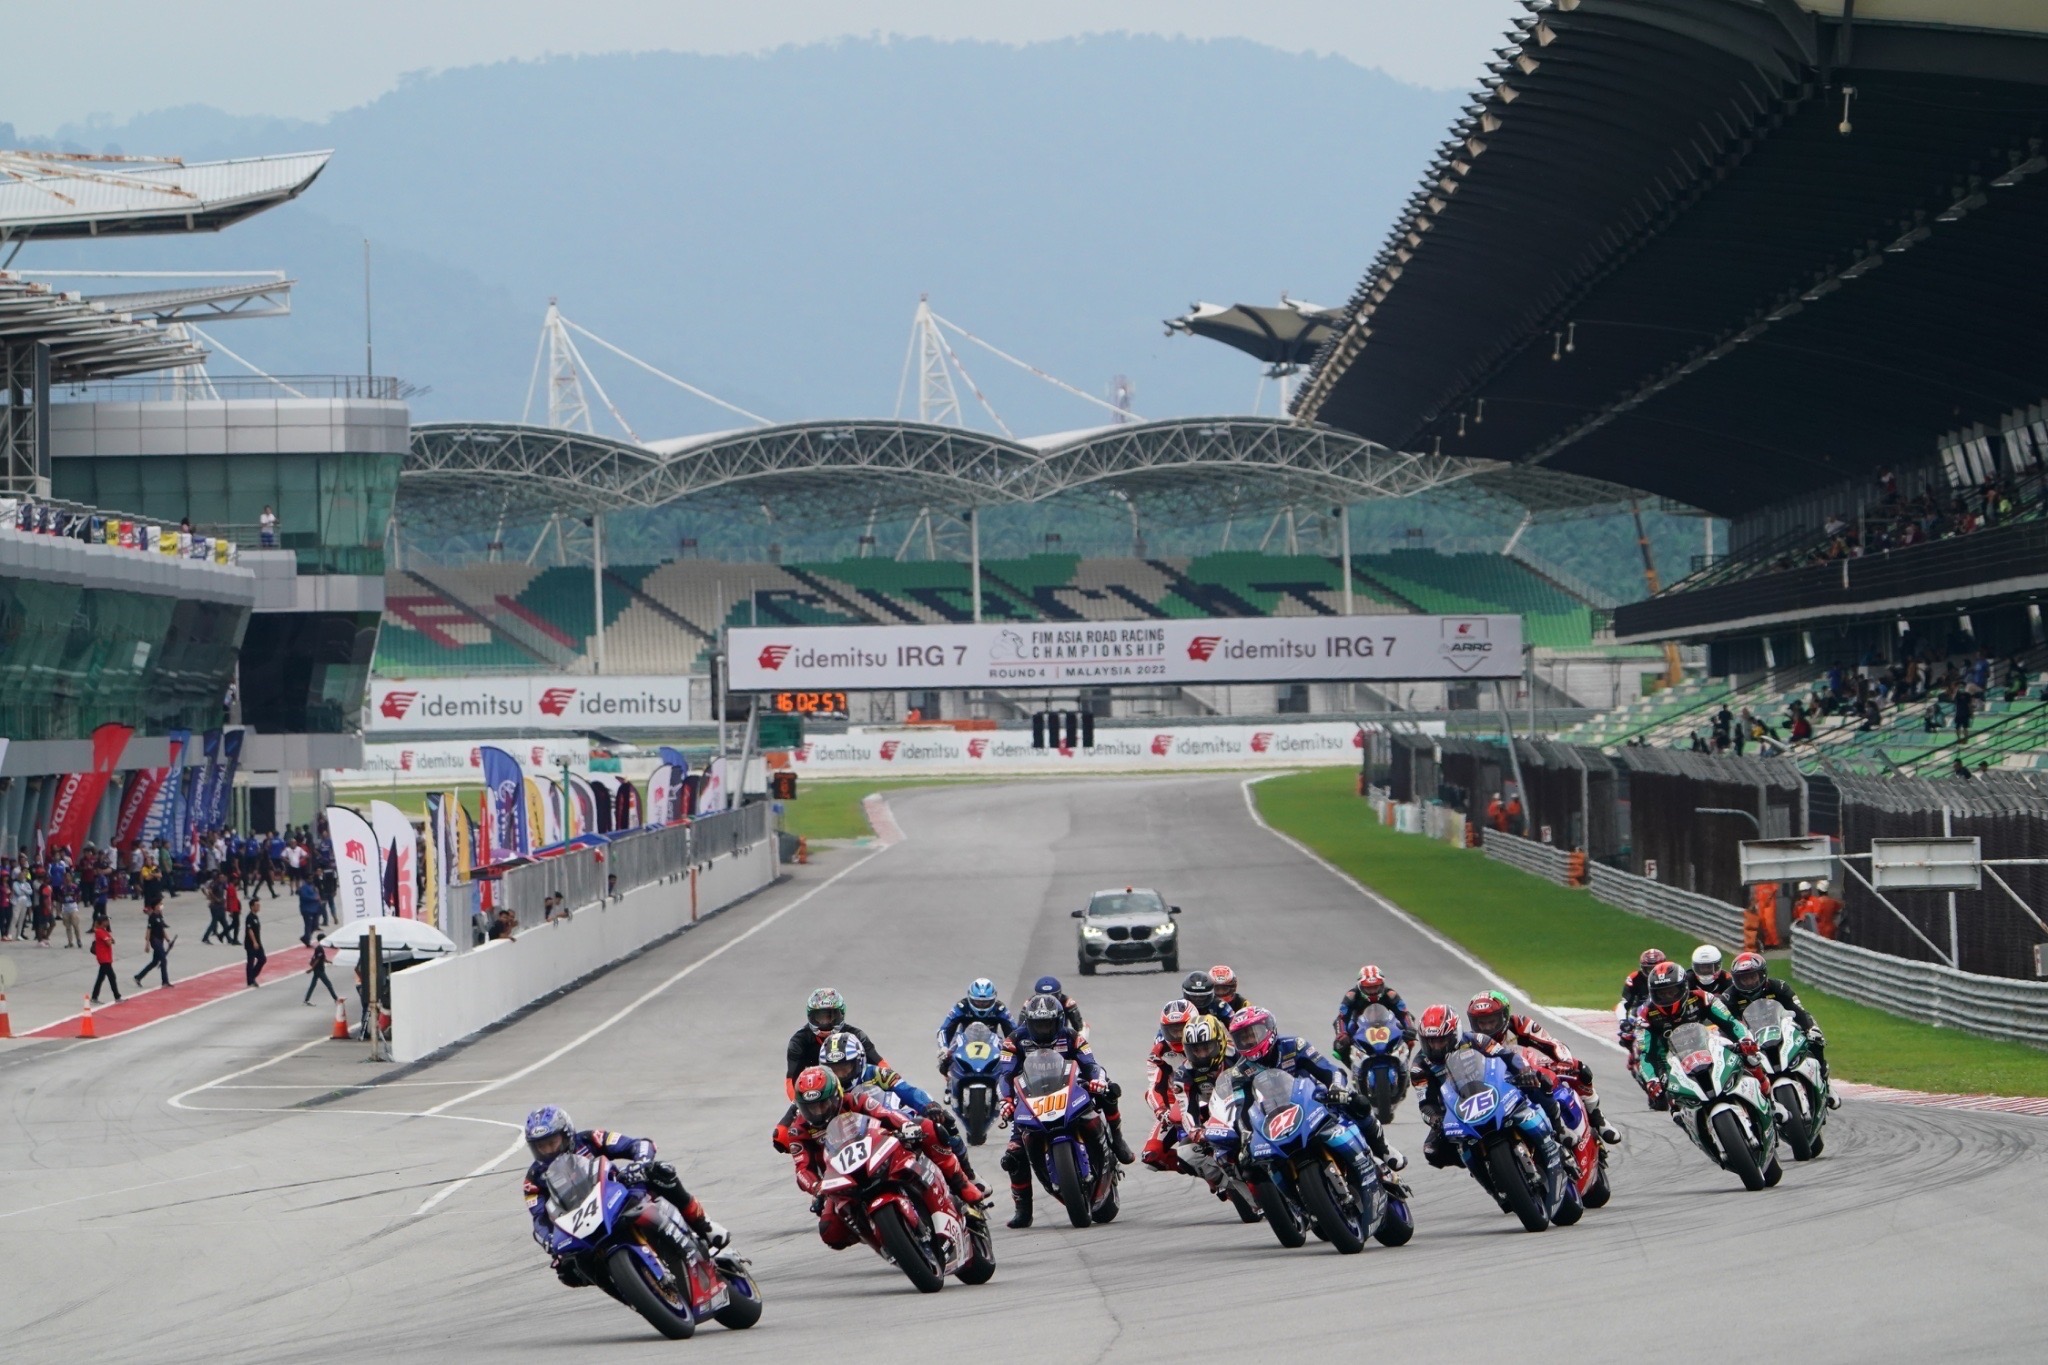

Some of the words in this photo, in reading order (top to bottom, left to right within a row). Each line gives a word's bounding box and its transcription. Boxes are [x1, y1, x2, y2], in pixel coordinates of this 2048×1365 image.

[1032, 630, 1053, 644] FIM
[1057, 630, 1083, 643] ASIA
[1086, 629, 1117, 643] ROAD
[1121, 628, 1164, 642] RACING
[1224, 637, 1316, 659] idemitsu
[1326, 636, 1373, 657] IRG
[1382, 636, 1396, 657] 7
[1451, 642, 1492, 652] ARRC
[795, 647, 887, 669] idemitsu
[897, 645, 944, 667] IRG
[953, 645, 967, 666] 7
[1032, 643, 1165, 659] CHAMPIONSHIP
[989, 668, 1036, 678] ROUND
[1039, 668, 1045, 677] 4
[1065, 666, 1131, 677] MALAYSIA
[1137, 665, 1166, 675] 2022
[421, 692, 523, 717] idemitsu
[580, 687, 682, 714] idemitsu
[814, 743, 871, 761] idemitsu
[902, 742, 959, 759] idemitsu
[1176, 736, 1241, 755] idemitsu
[1275, 733, 1343, 751] idemitsu
[114, 777, 150, 844] HONDA
[351, 868, 370, 918] idemi
[1369, 1028, 1388, 1042] 16
[974, 1044, 984, 1056] 7
[1033, 1093, 1067, 1116] 500
[1459, 1089, 1495, 1122] 76
[1269, 1105, 1299, 1139] 27
[838, 1142, 868, 1172] 123
[572, 1197, 599, 1234] 24
